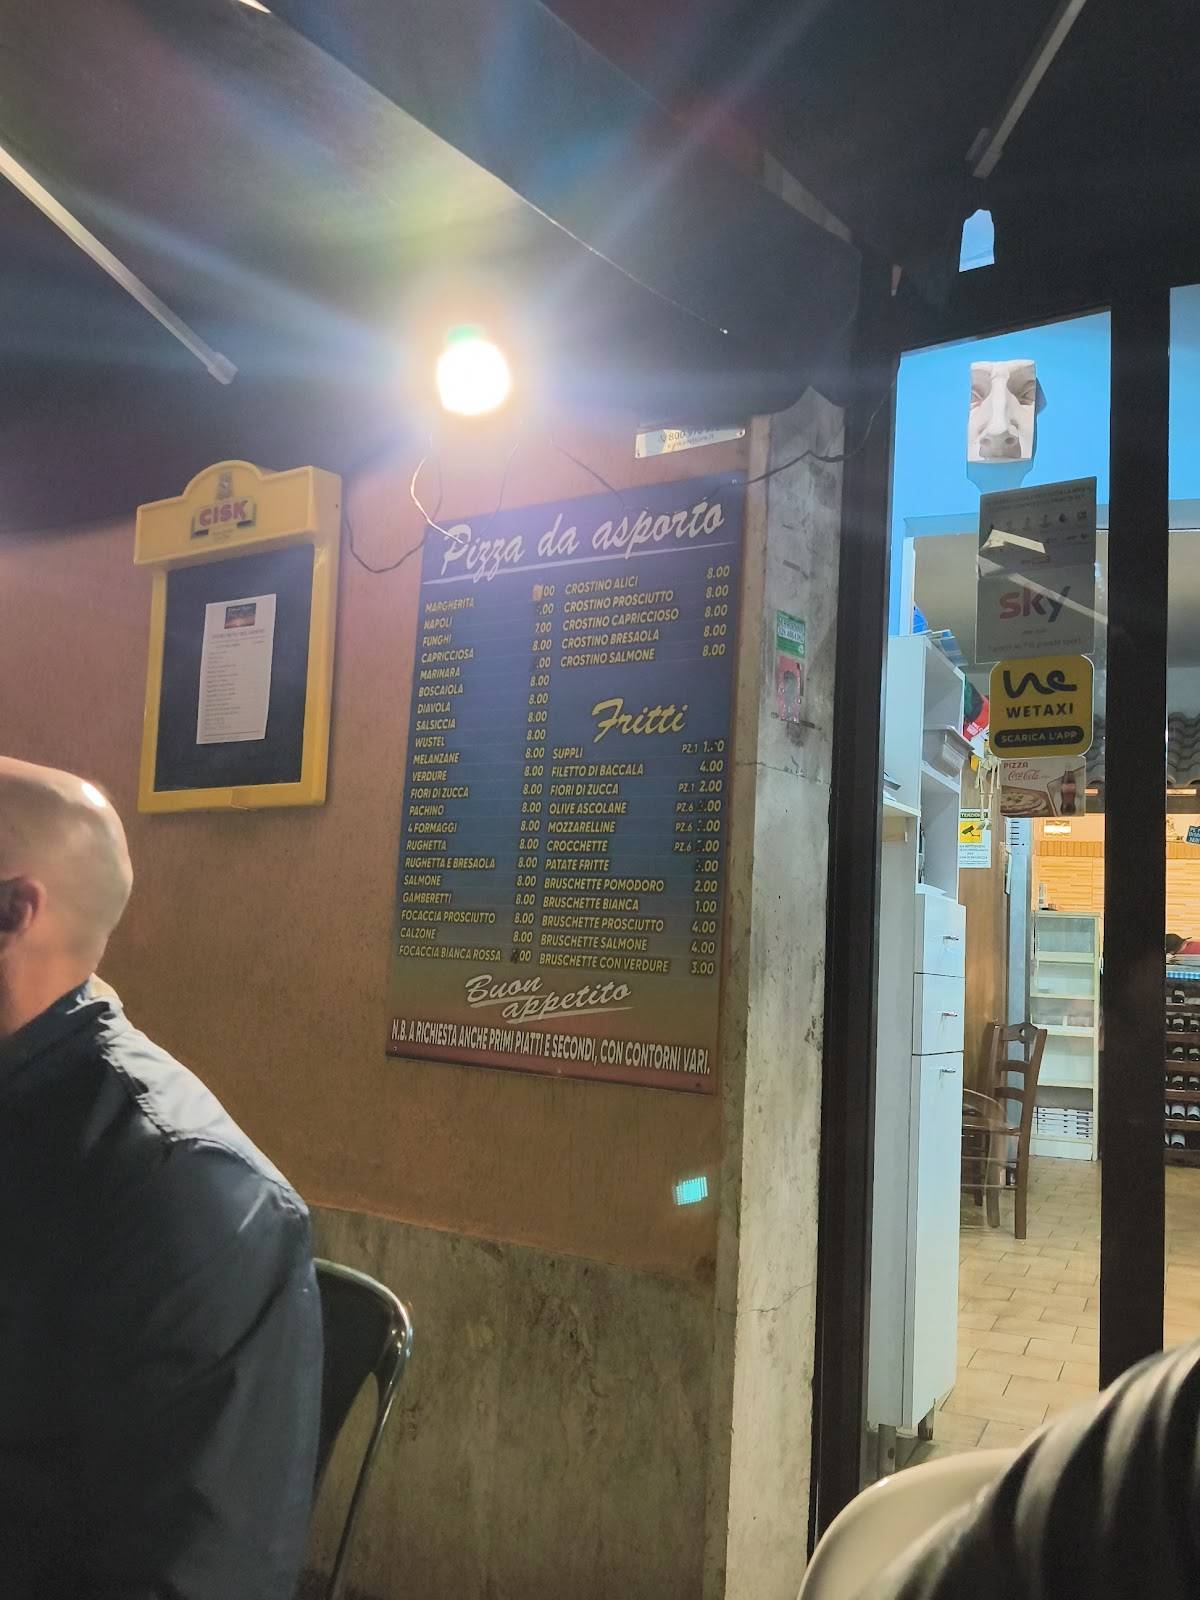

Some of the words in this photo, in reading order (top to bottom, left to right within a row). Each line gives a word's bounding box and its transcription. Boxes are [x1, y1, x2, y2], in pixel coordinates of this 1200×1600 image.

[200, 500, 248, 527] CISK
[440, 523, 525, 583] Pizza
[537, 513, 579, 558] da
[591, 497, 725, 560] asporto
[565, 578, 612, 595] CROSTINO
[613, 575, 639, 589] ALICI
[707, 565, 730, 579] 8.00
[425, 597, 475, 613] MARGHERITA
[564, 598, 611, 613] CROSTINO
[612, 590, 674, 608] PROSCIUTTO
[706, 584, 729, 598] 8.00
[999, 586, 1071, 623] sky
[423, 617, 452, 630] NAPOLI
[563, 615, 610, 631] CROSTINO
[611, 608, 679, 626] CAPRICCIOSO
[704, 604, 728, 618] 8.00
[423, 634, 451, 647] FUNGHI
[561, 634, 609, 649] CROSTINO
[610, 629, 660, 645] BRESAOLA
[703, 623, 727, 638] 8.00
[421, 648, 474, 663] CAPRICCIOSA
[560, 652, 608, 667] CROSTINO
[609, 648, 655, 664] SALMONE
[702, 643, 726, 657] 8.00
[420, 667, 461, 680] MARINARA
[418, 683, 464, 697] BOSCAIOLA
[530, 675, 550, 687] 8.00
[417, 702, 451, 714] DIAVOLA
[528, 693, 548, 705] 8.00
[1006, 703, 1074, 718] WETAXI
[416, 719, 456, 731] SALSICCIA
[528, 711, 547, 723] 8.00
[591, 698, 689, 743] Fritti
[415, 736, 445, 748] WUSTEL
[527, 729, 546, 741] 8.00
[1000, 732, 1047, 744] SCARICA
[1049, 731, 1078, 740] L'APP
[413, 752, 460, 765] MELANZANE
[525, 747, 545, 759] 8.00
[552, 747, 584, 760] SUPPLI
[551, 765, 586, 778] FILETTO
[588, 765, 598, 777] DI
[599, 763, 644, 777] BACCALA
[700, 760, 723, 772] 4.00
[1004, 761, 1028, 769] PIZZA
[412, 770, 448, 782] VERDURE
[524, 765, 544, 777] 8.00
[410, 788, 431, 799] FIORI
[432, 788, 441, 798] DI
[442, 787, 469, 798] ZUCCA
[523, 783, 543, 795] 8.00
[550, 784, 574, 796] FIORI
[575, 784, 586, 796] DI
[587, 783, 619, 796] ZUCCA
[699, 779, 722, 792] 2.00
[409, 805, 445, 816] PACHINO
[522, 802, 541, 813] 8.00
[549, 802, 575, 815] OLIVE
[576, 802, 627, 814] ASCOLANE
[413, 822, 458, 833] FORMAGGI
[521, 820, 540, 831] 8.00
[547, 821, 616, 833] MOZZARELLINE
[406, 840, 447, 851] RUGHETTA
[519, 838, 539, 850] 8.00
[546, 840, 609, 852] CROCCHETTE
[405, 857, 446, 868] RUGHETTA
[447, 858, 453, 868] E
[453, 858, 496, 869] BRESAOLA
[518, 857, 538, 868] 8.00
[545, 859, 577, 871] PATATE
[579, 859, 610, 871] FRITTE
[403, 874, 442, 886] SALMONE
[517, 875, 536, 887] 8.00
[544, 877, 602, 890] BRUSCHETTE
[603, 879, 665, 892] POMODORO
[694, 880, 718, 893] 2.00
[402, 892, 452, 904] GAMBERETTI
[515, 894, 536, 905] 8.00
[543, 896, 601, 909] BRUSCHETTE
[602, 898, 639, 911] BIANCA
[695, 900, 717, 913] 1.00
[401, 909, 442, 921] FOCACCIA
[443, 911, 496, 924] PROSCIUTTO
[514, 912, 535, 924] 8.00
[542, 915, 600, 929] BRUSCHETTE
[601, 917, 664, 932] PROSCIUTTO
[691, 921, 716, 934] 4.00
[400, 927, 437, 940] CALZONE
[513, 931, 533, 943] 8.00
[540, 934, 600, 948] BRUSCHETTE
[600, 937, 648, 951] SALMONE
[691, 941, 715, 954] 4.00
[399, 945, 440, 957] FOCACCIA
[441, 947, 471, 960] BIANCA
[472, 949, 501, 961] ROSSA
[539, 953, 598, 968] BRUSCHETTE
[600, 956, 621, 969] CON
[623, 959, 669, 973] VERDURE
[691, 961, 714, 975] 3.00
[465, 974, 543, 1002] Buon
[501, 981, 632, 1021] appetito
[392, 1019, 407, 1041] N.B.
[408, 1021, 415, 1042] A
[416, 1021, 457, 1047] RICHIESTA
[458, 1025, 488, 1050] ANCHE
[489, 1028, 515, 1053] PRIMI
[514, 1031, 544, 1056] PIATTI
[544, 1034, 551, 1057] E
[551, 1034, 598, 1067] SECONDI,
[600, 1039, 624, 1065] CON
[625, 1041, 682, 1071] CONTORNI
[683, 1047, 711, 1075] VARI.
